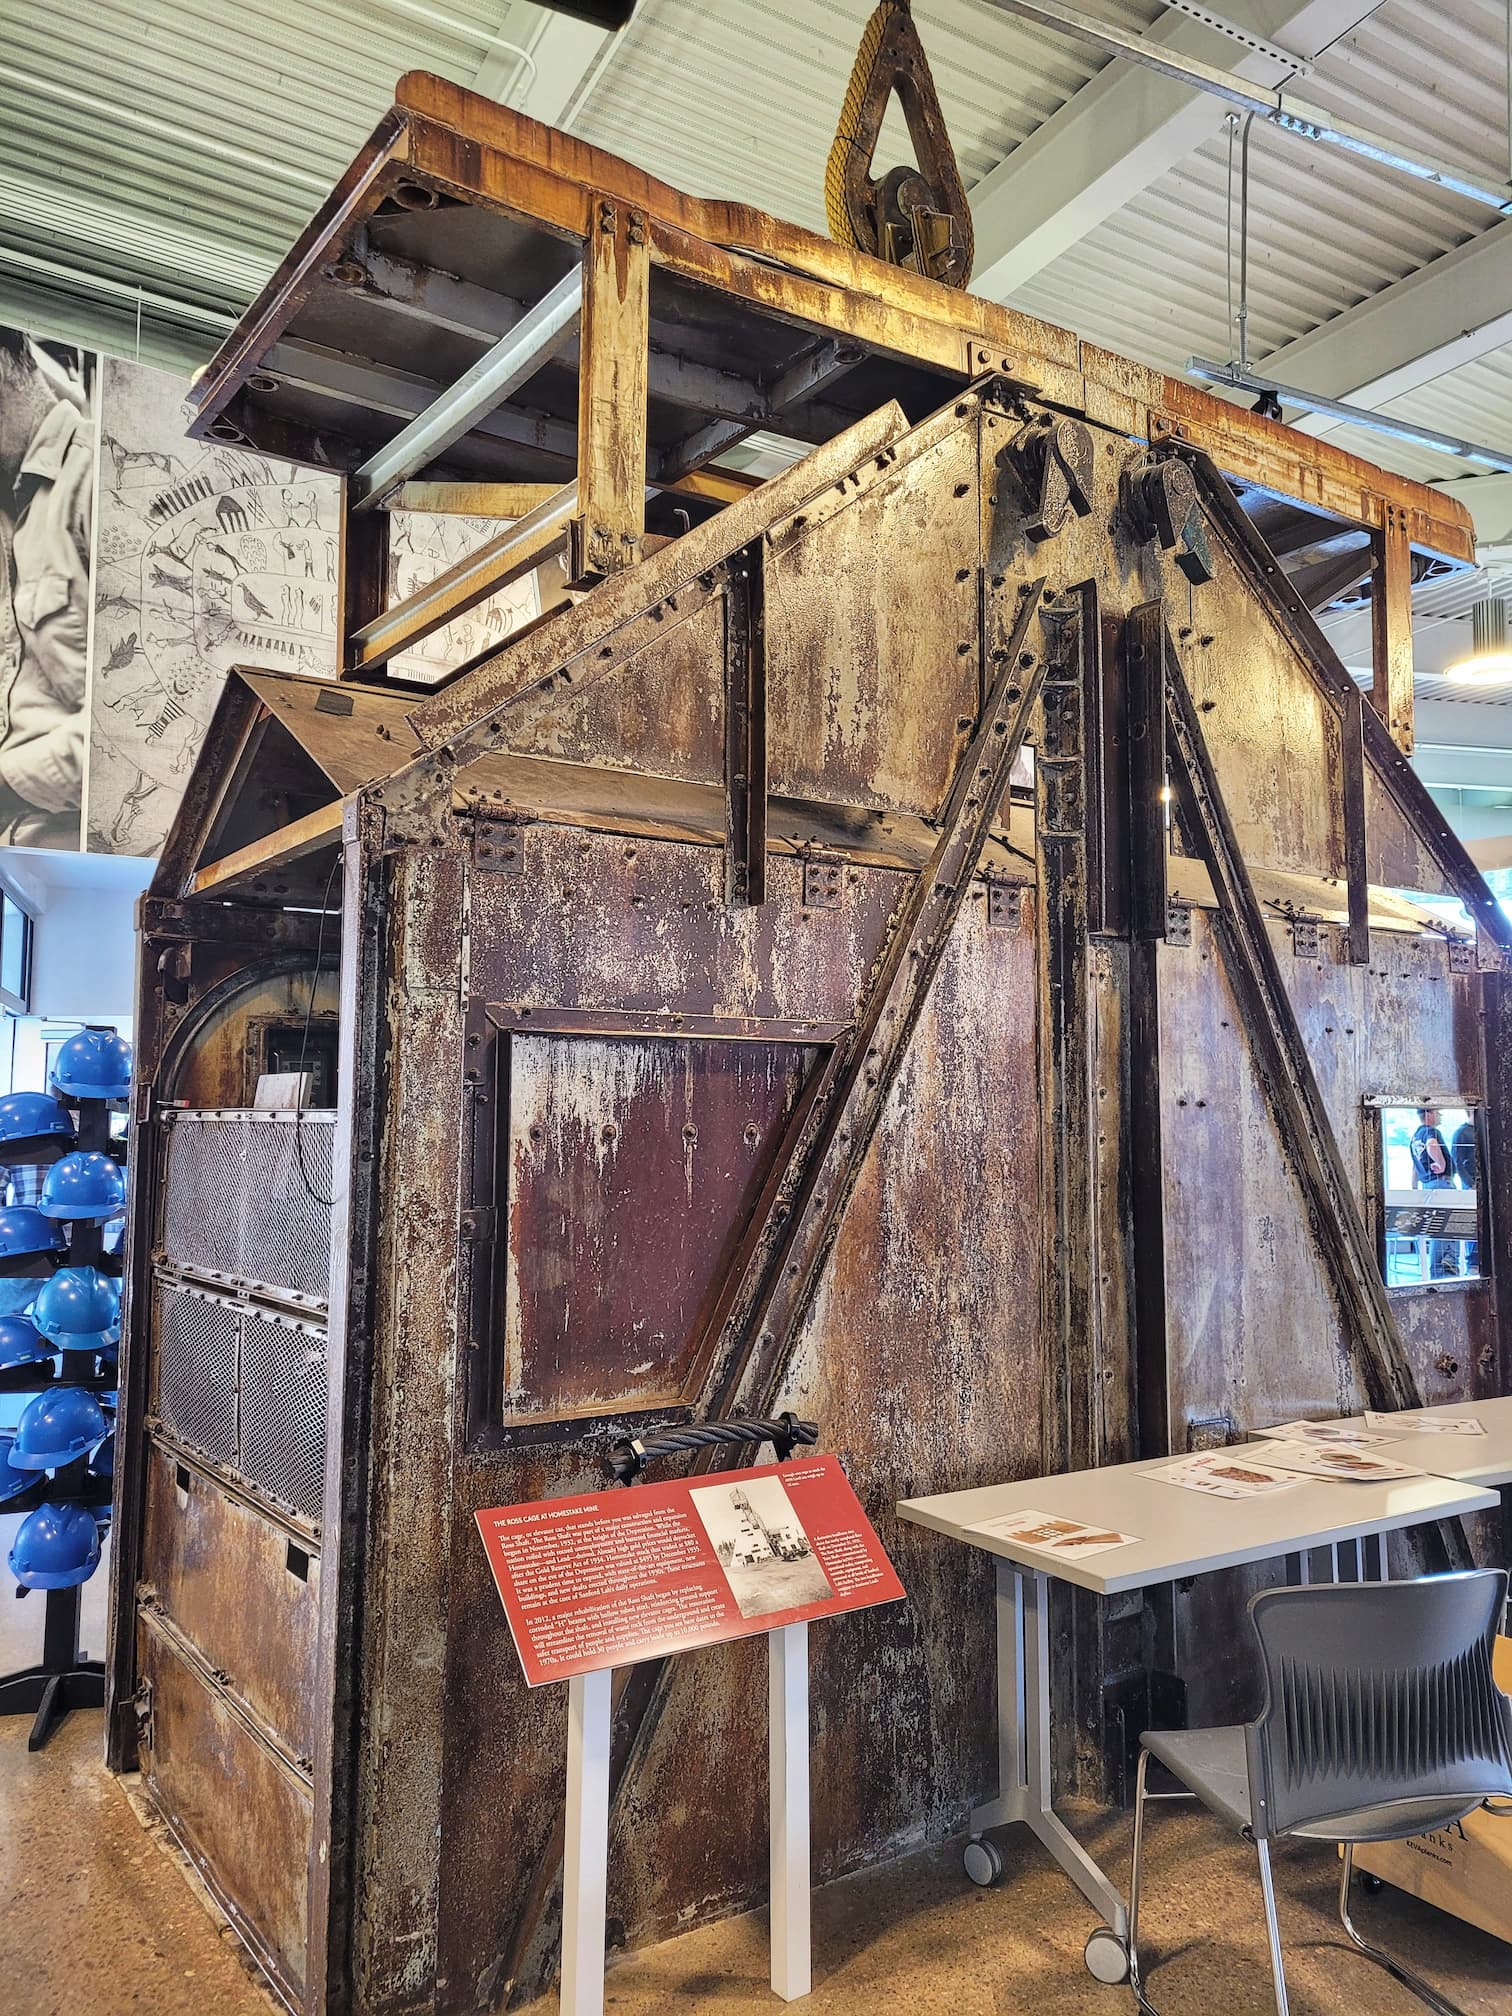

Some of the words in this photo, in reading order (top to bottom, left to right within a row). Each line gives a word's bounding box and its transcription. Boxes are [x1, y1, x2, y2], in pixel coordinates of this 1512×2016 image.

[494, 1519, 507, 1528] THE
[506, 1517, 523, 1526] ROSS
[523, 1514, 541, 1523] CAGE
[548, 1507, 584, 1519] HOMESTAKE
[583, 1504, 599, 1513] MINE
[1421, 1832, 1453, 1852] anks
